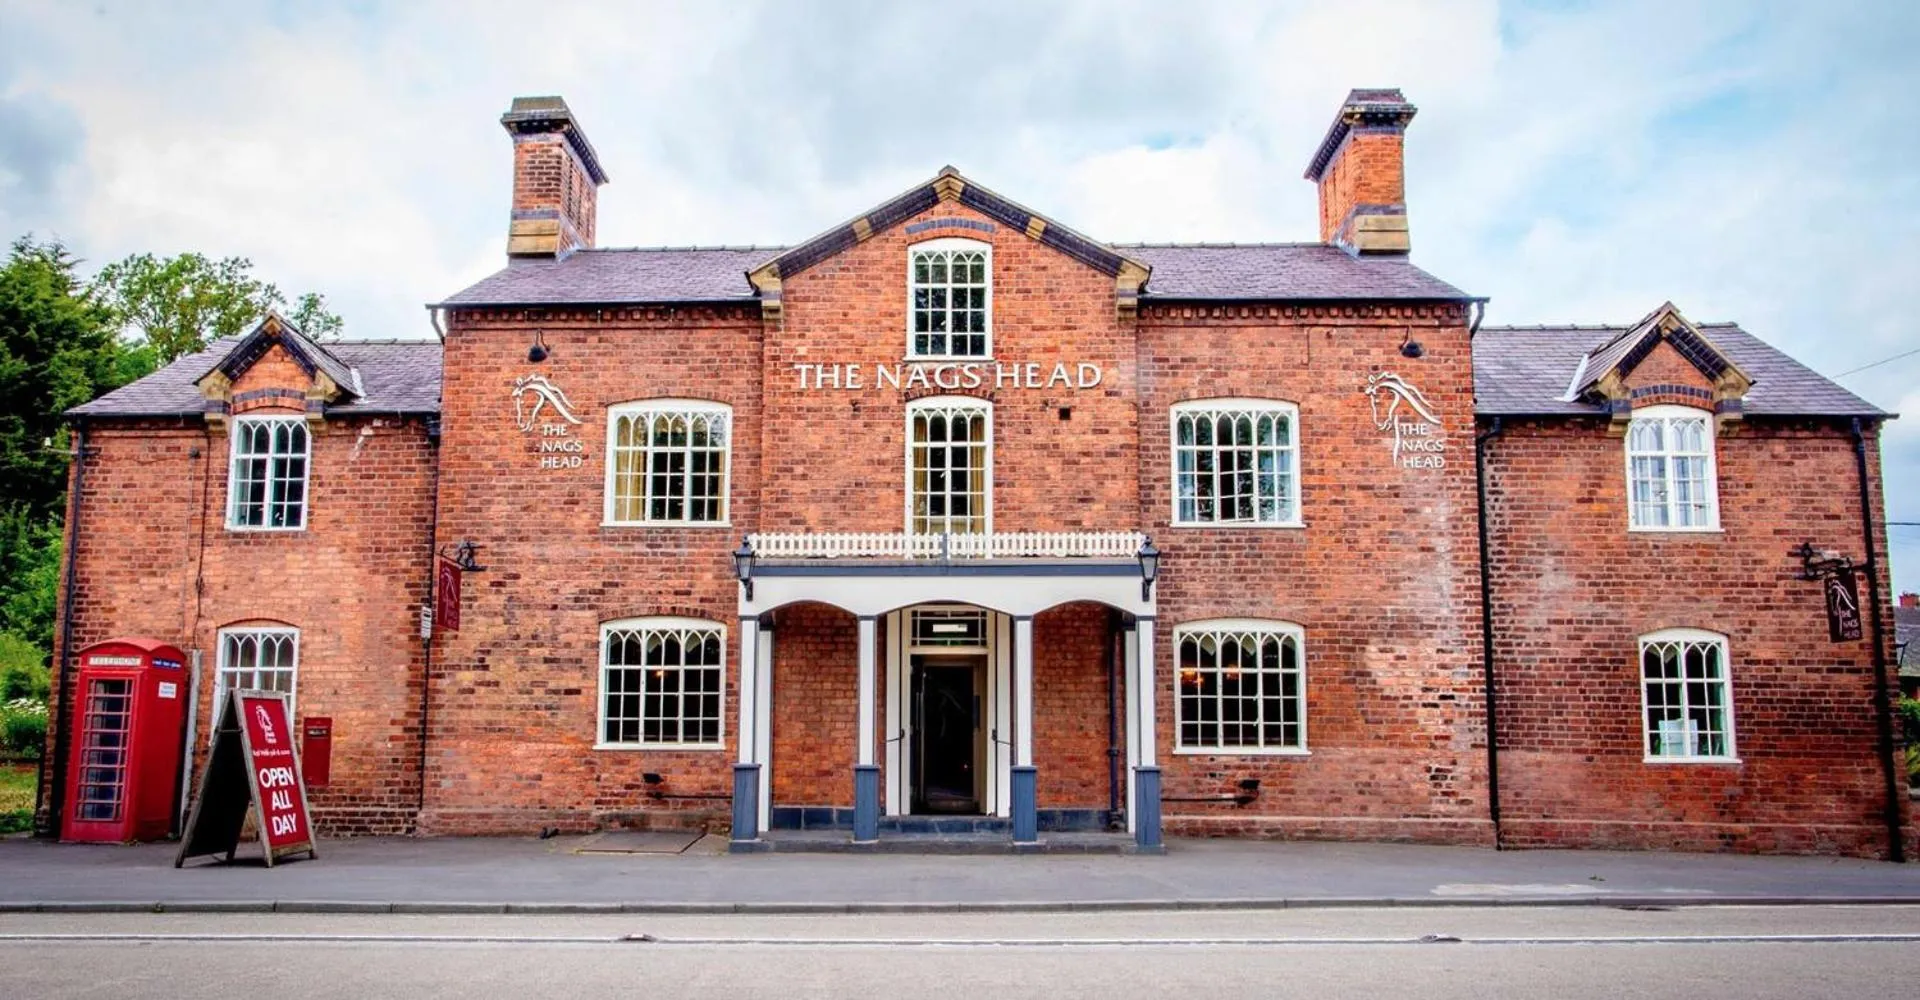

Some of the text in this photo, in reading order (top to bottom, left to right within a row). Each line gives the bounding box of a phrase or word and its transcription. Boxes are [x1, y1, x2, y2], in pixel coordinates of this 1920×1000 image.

[794, 362, 1102, 389] THE NAGS HEAD
[542, 423, 568, 436] THE
[1400, 423, 1428, 436] THE
[541, 440, 583, 453] NAGS
[1402, 440, 1445, 452] NAGS
[541, 456, 582, 469] HEAD
[1402, 456, 1446, 469] HEAD
[91, 656, 140, 666] TELEPHONE
[259, 766, 295, 788] OPEN
[271, 789, 294, 811] ALL
[271, 812, 297, 837] DAY
